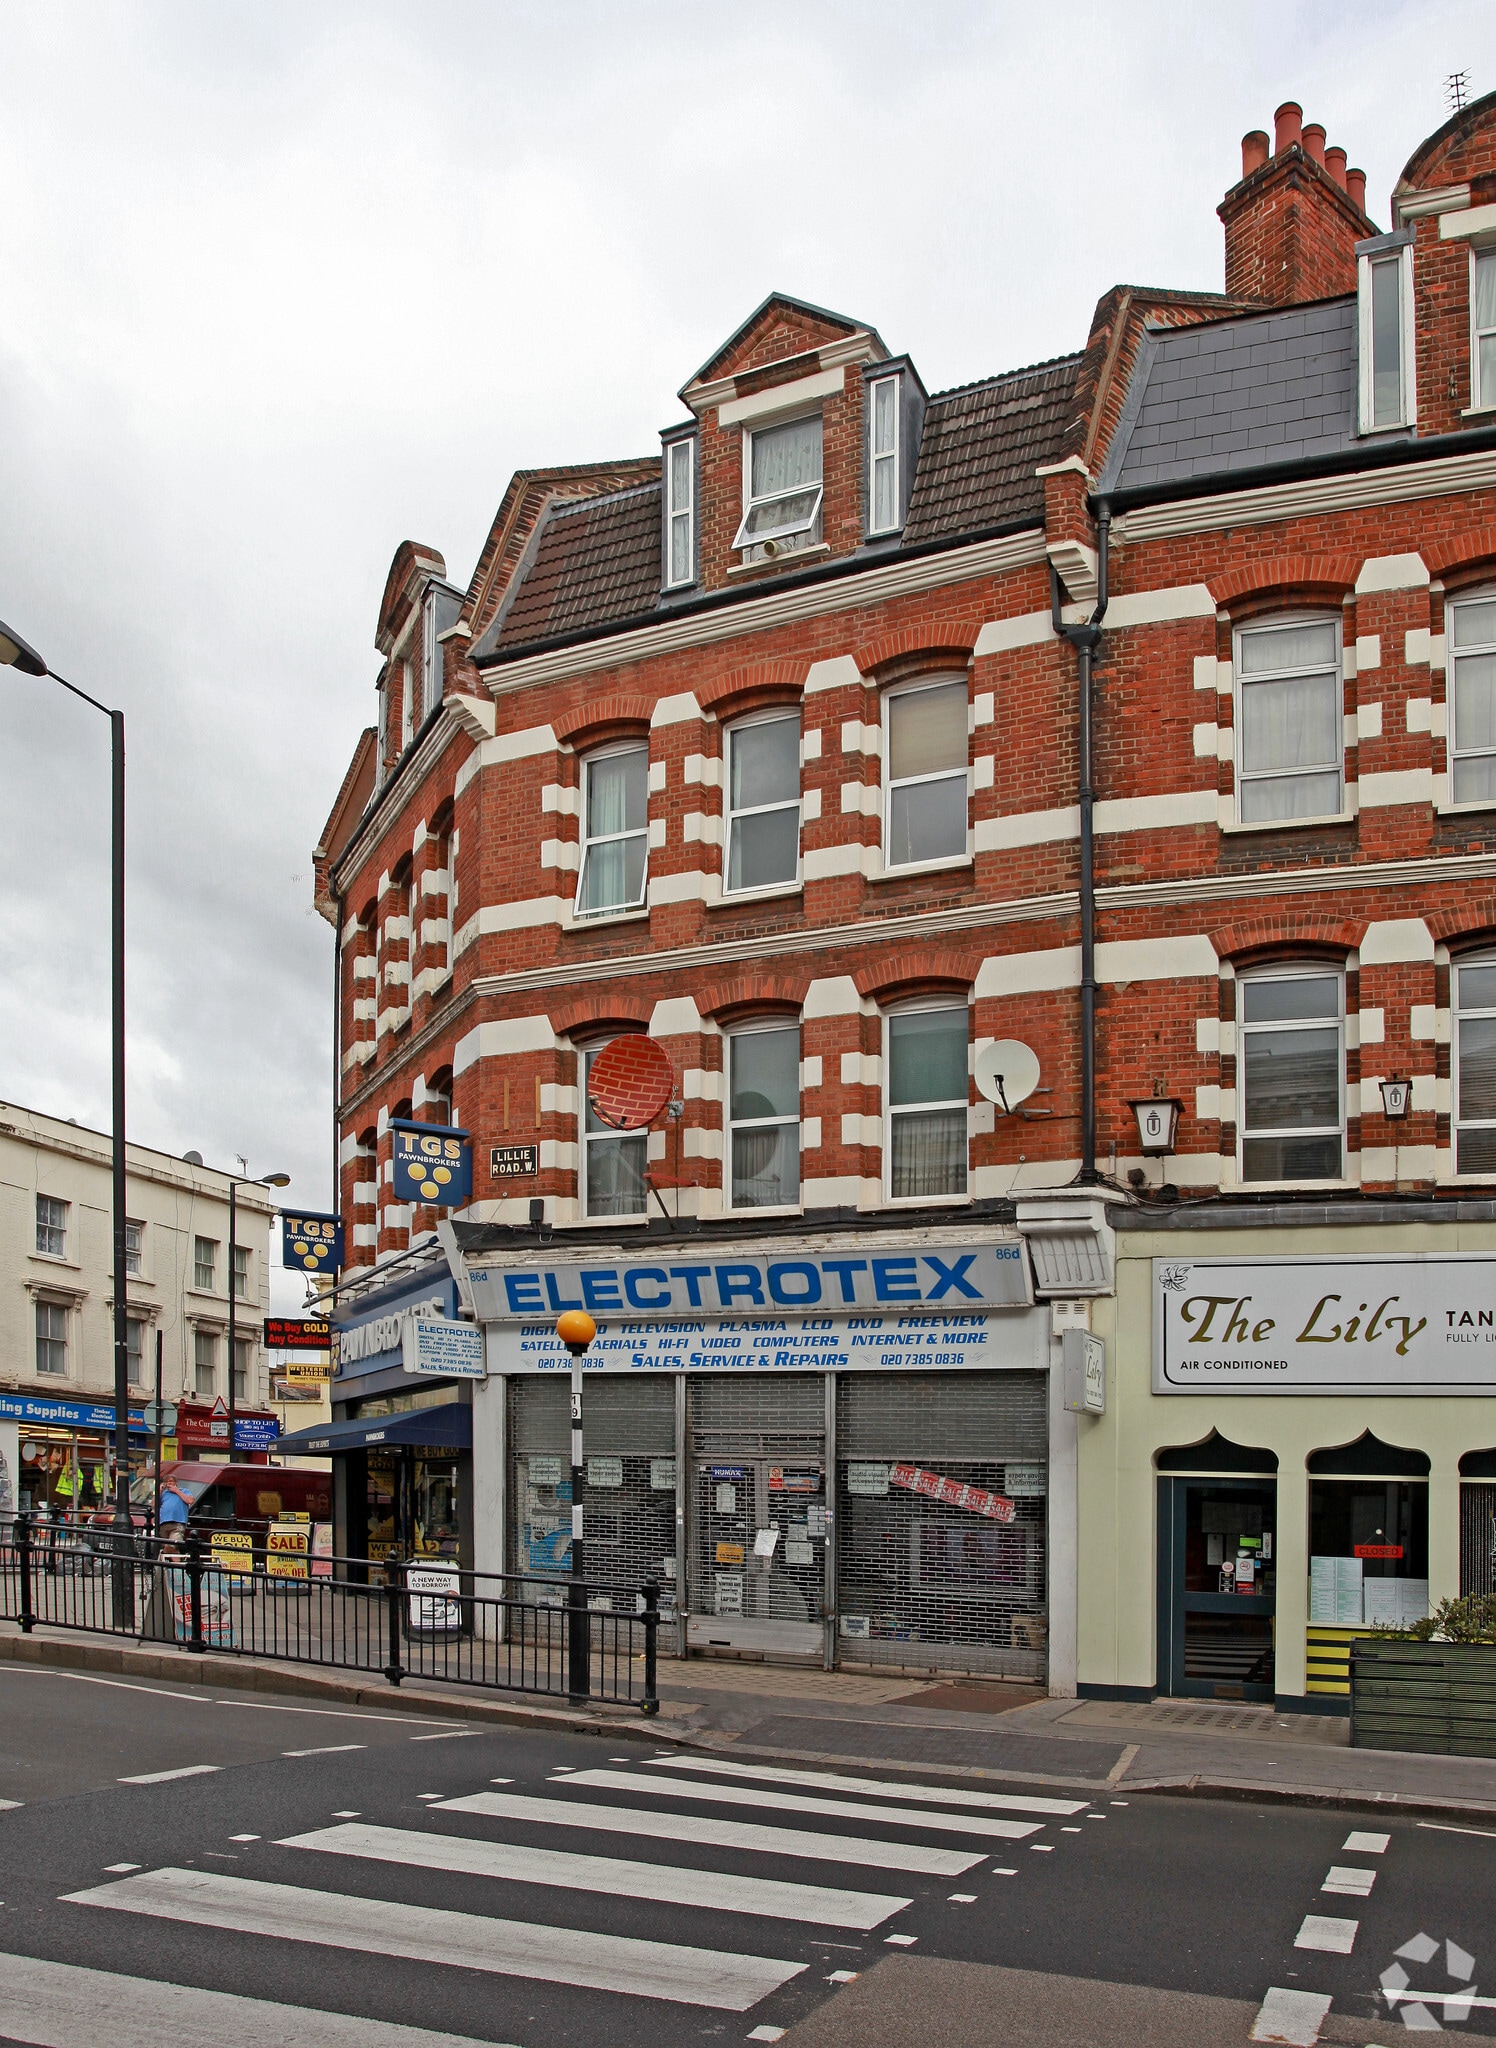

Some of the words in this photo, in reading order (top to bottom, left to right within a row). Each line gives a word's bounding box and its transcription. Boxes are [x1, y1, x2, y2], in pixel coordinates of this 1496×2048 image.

[398, 1131, 461, 1160] TGS
[398, 1152, 461, 1168] PAWNBROKERS
[497, 1150, 530, 1162] LILLIE
[286, 1218, 336, 1239] TGS
[286, 1233, 336, 1245] PAWNBROKERS
[995, 1248, 1020, 1260] 86d
[470, 1271, 488, 1283] 86d
[503, 1254, 984, 1312] ELECTROTEX
[268, 1322, 282, 1332] We
[284, 1322, 301, 1334] Buy
[303, 1323, 329, 1333] GOLD
[418, 1325, 482, 1338] ELECTROTEX
[520, 1325, 558, 1336] DIGIT
[620, 1322, 706, 1334] TELEVISION
[718, 1320, 787, 1332] PLASMA
[801, 1318, 833, 1330] LCD
[847, 1317, 883, 1329] DVD
[897, 1314, 989, 1328] FREEVIEW
[1180, 1295, 1276, 1344] The
[1295, 1294, 1427, 1356] Lily
[268, 1334, 285, 1346] Any
[287, 1334, 329, 1345] Condition
[592, 1339, 648, 1350] AERIALS
[658, 1338, 688, 1349] HI-FI
[700, 1337, 742, 1348] VIDEO
[753, 1335, 840, 1348] COMPUTERS
[851, 1333, 923, 1346] INTERNET
[926, 1333, 938, 1344] &
[941, 1332, 989, 1344] MORE
[1446, 1333, 1479, 1342] FULLY
[1485, 1333, 1496, 1342] LI
[537, 1359, 555, 1368] 020
[556, 1358, 573, 1368] 738
[758, 1354, 770, 1366] &
[880, 1354, 901, 1366] 020
[904, 1353, 934, 1365] 7385
[935, 1353, 964, 1365] 0836
[1180, 1361, 1200, 1369] AIR
[1203, 1360, 1288, 1370] CONDITIONED
[1087, 1355, 1102, 1388] Lily
[26, 1402, 79, 1420] Supplies
[185, 1418, 198, 1426] The
[270, 1536, 305, 1550] SALE
[1358, 1547, 1399, 1556] CLOSED
[271, 1568, 290, 1576] 70%
[291, 1568, 306, 1577] OFF
